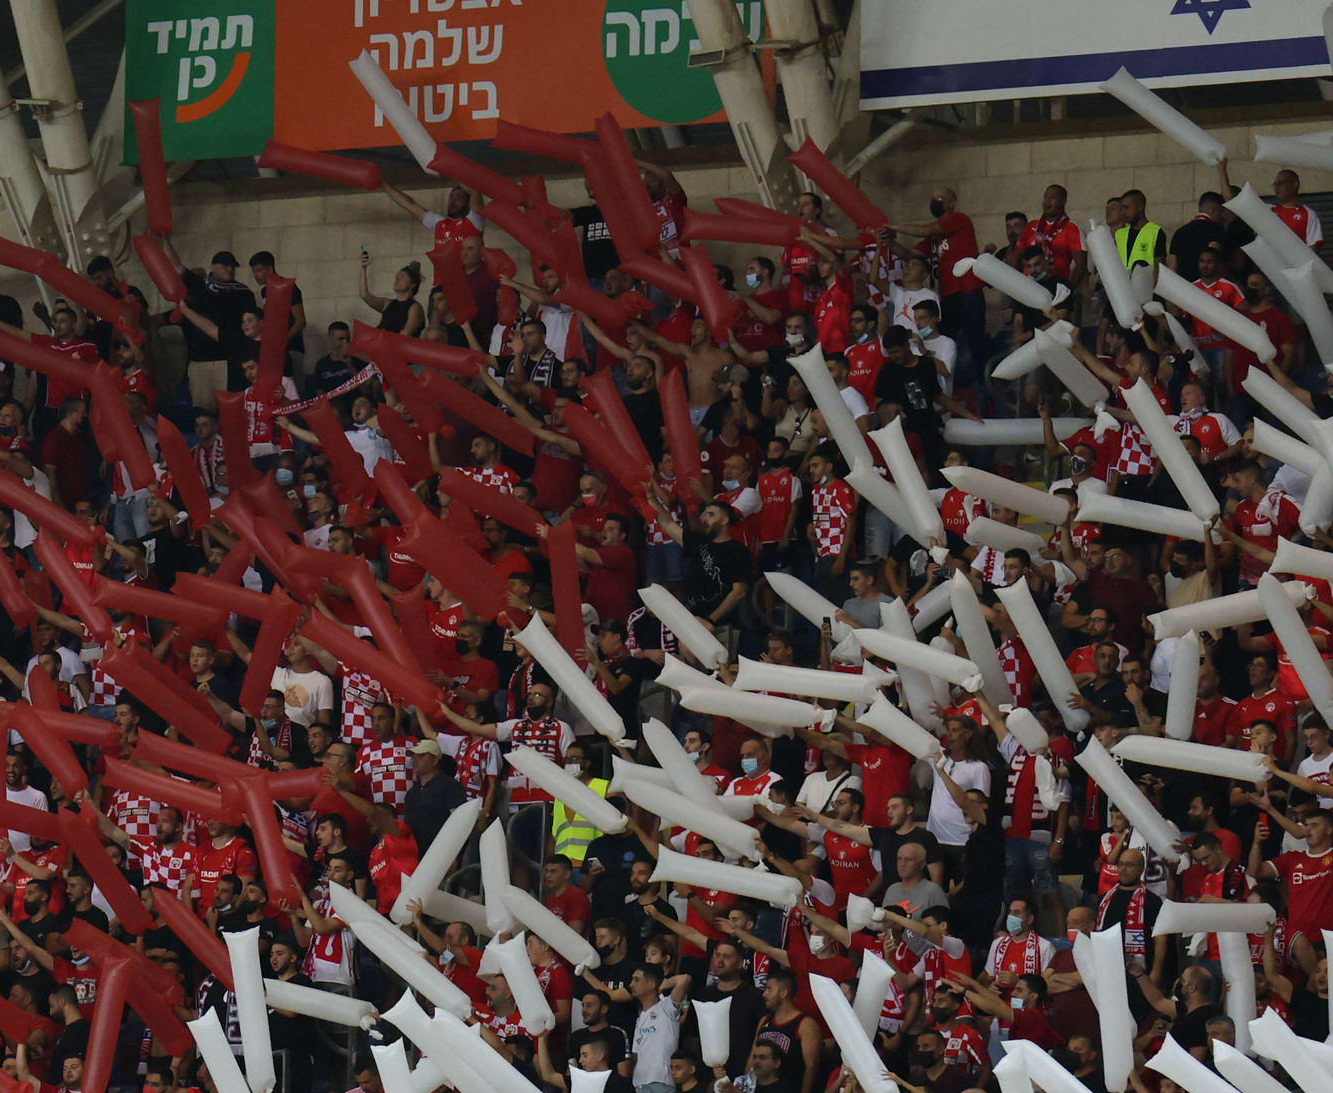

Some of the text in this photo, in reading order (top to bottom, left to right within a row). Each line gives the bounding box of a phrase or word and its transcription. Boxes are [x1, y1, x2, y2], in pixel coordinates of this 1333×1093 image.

[147, 14, 254, 55] תמיד
[370, 19, 504, 71] שלמה
[177, 55, 217, 101] כן
